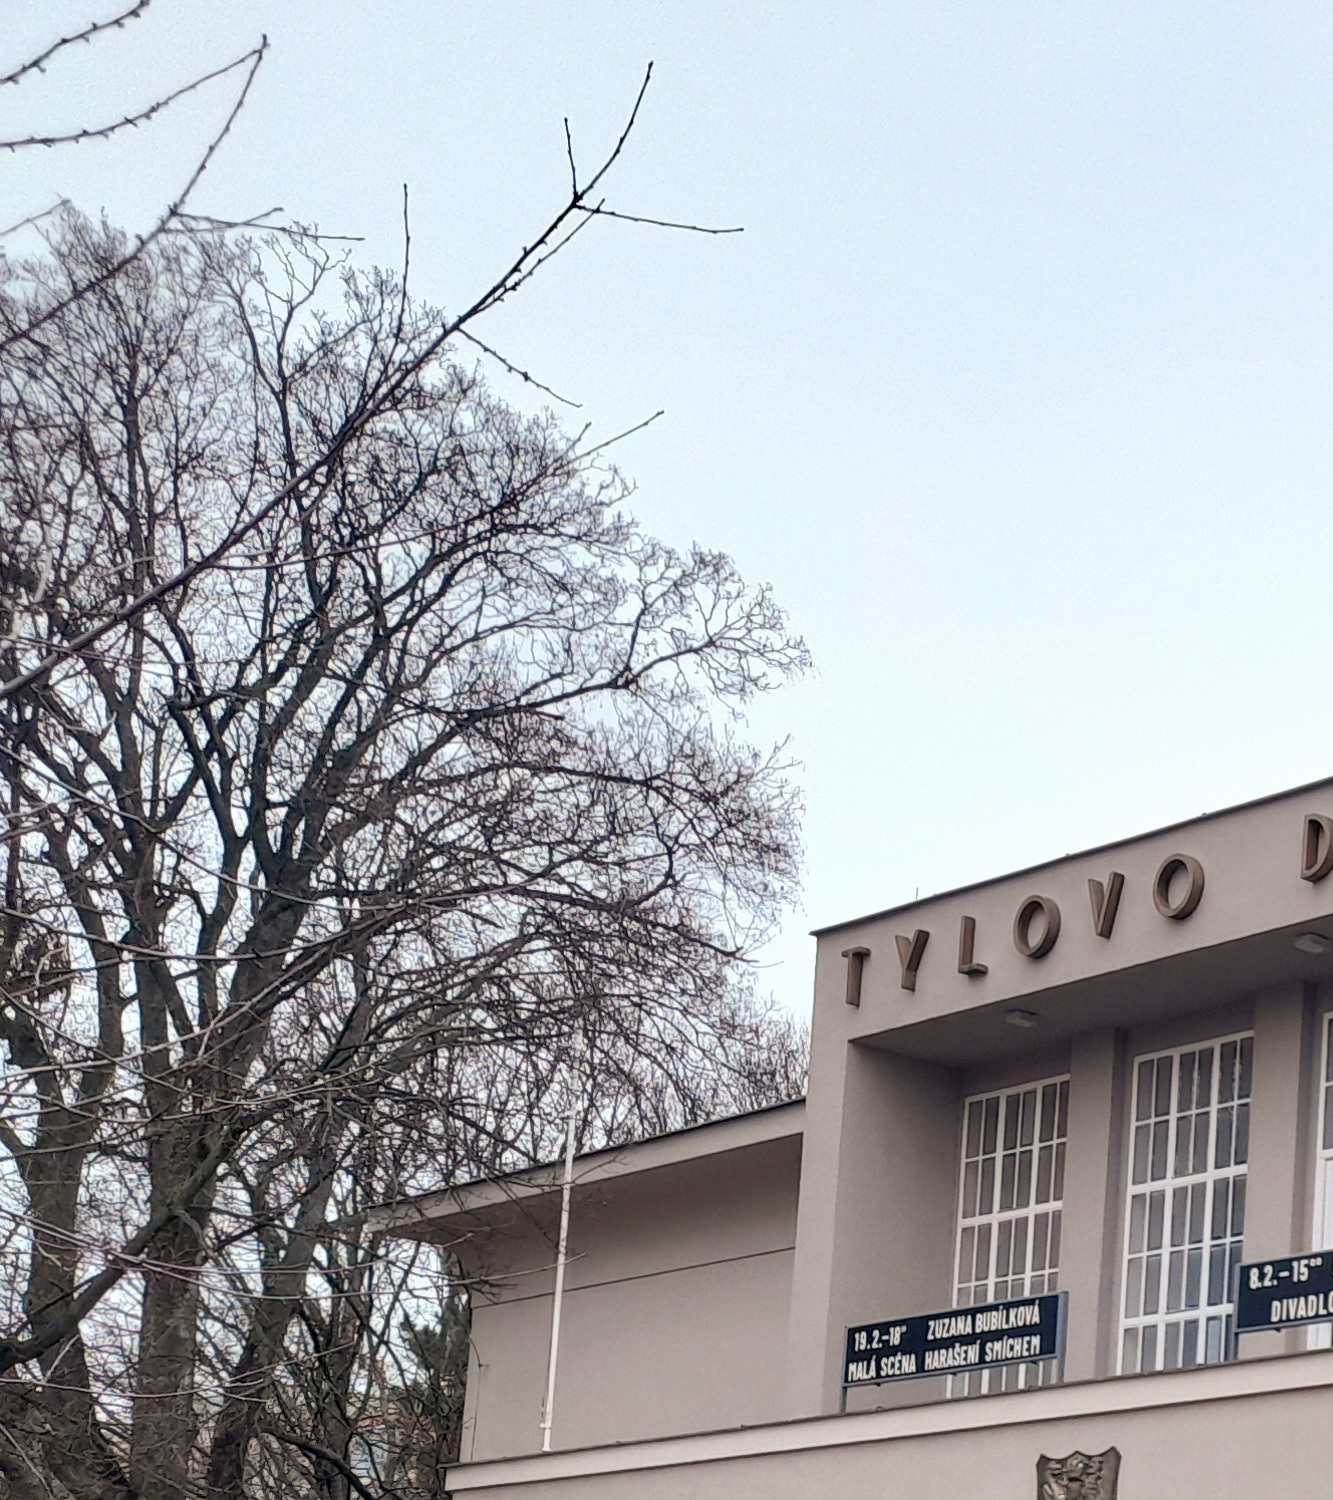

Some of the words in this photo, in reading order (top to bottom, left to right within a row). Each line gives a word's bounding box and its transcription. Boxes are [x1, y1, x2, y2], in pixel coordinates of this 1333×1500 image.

[841, 852, 1206, 1008] TYLOVO
[926, 1315, 973, 1341] ZUZANA
[974, 1299, 1041, 1334] BUBÍLKOVÁ
[847, 1354, 877, 1382] MALÁ
[880, 1352, 917, 1377] SCÉNA
[924, 1340, 980, 1371] HARAŠENÍ
[984, 1334, 1041, 1363] SMÍCHEM
